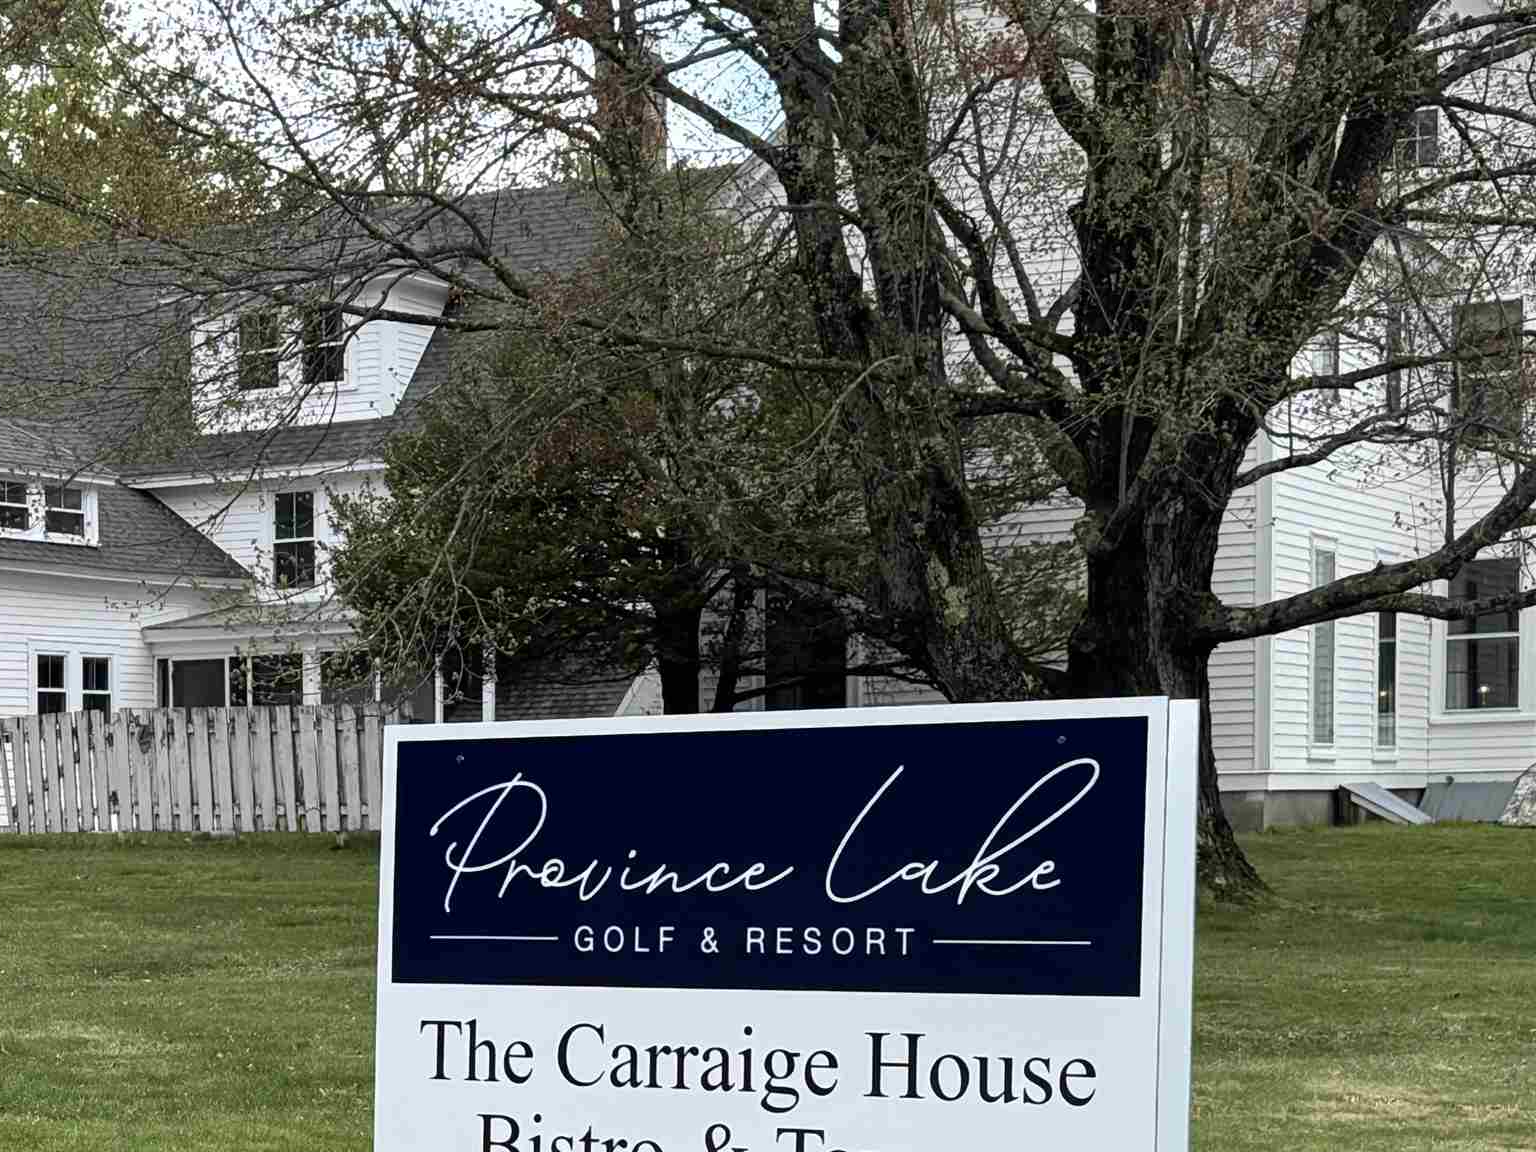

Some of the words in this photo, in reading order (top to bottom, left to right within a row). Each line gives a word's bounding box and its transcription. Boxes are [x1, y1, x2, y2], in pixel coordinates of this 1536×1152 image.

[430, 773, 793, 912] Province
[826, 758, 1099, 904] Lake
[575, 926, 674, 952] GOLF
[701, 927, 718, 953] &
[747, 927, 914, 955] RESORT
[421, 1019, 533, 1084] The
[558, 1024, 838, 1113] Carraige
[864, 1033, 1096, 1106] House
